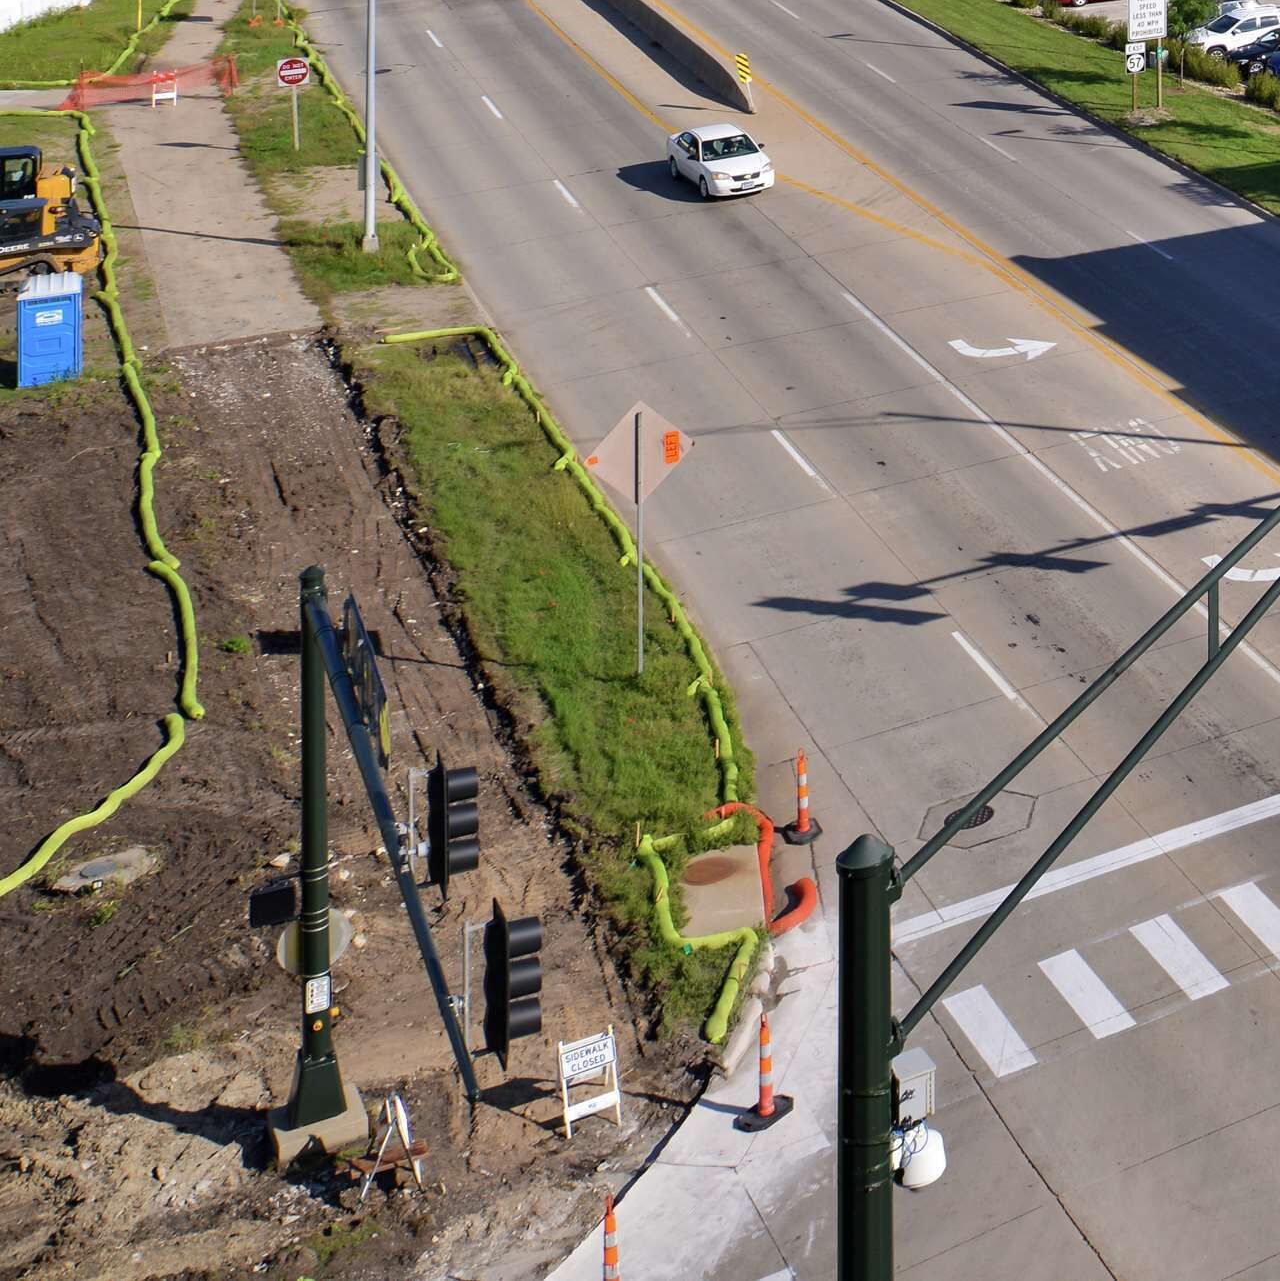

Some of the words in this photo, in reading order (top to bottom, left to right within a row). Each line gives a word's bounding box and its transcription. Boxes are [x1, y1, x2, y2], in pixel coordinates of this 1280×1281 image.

[1128, 44, 1143, 52] EAST
[1129, 57, 1142, 69] 57
[565, 1041, 609, 1064] SIDEWALK
[571, 1053, 606, 1073] CLOSED
